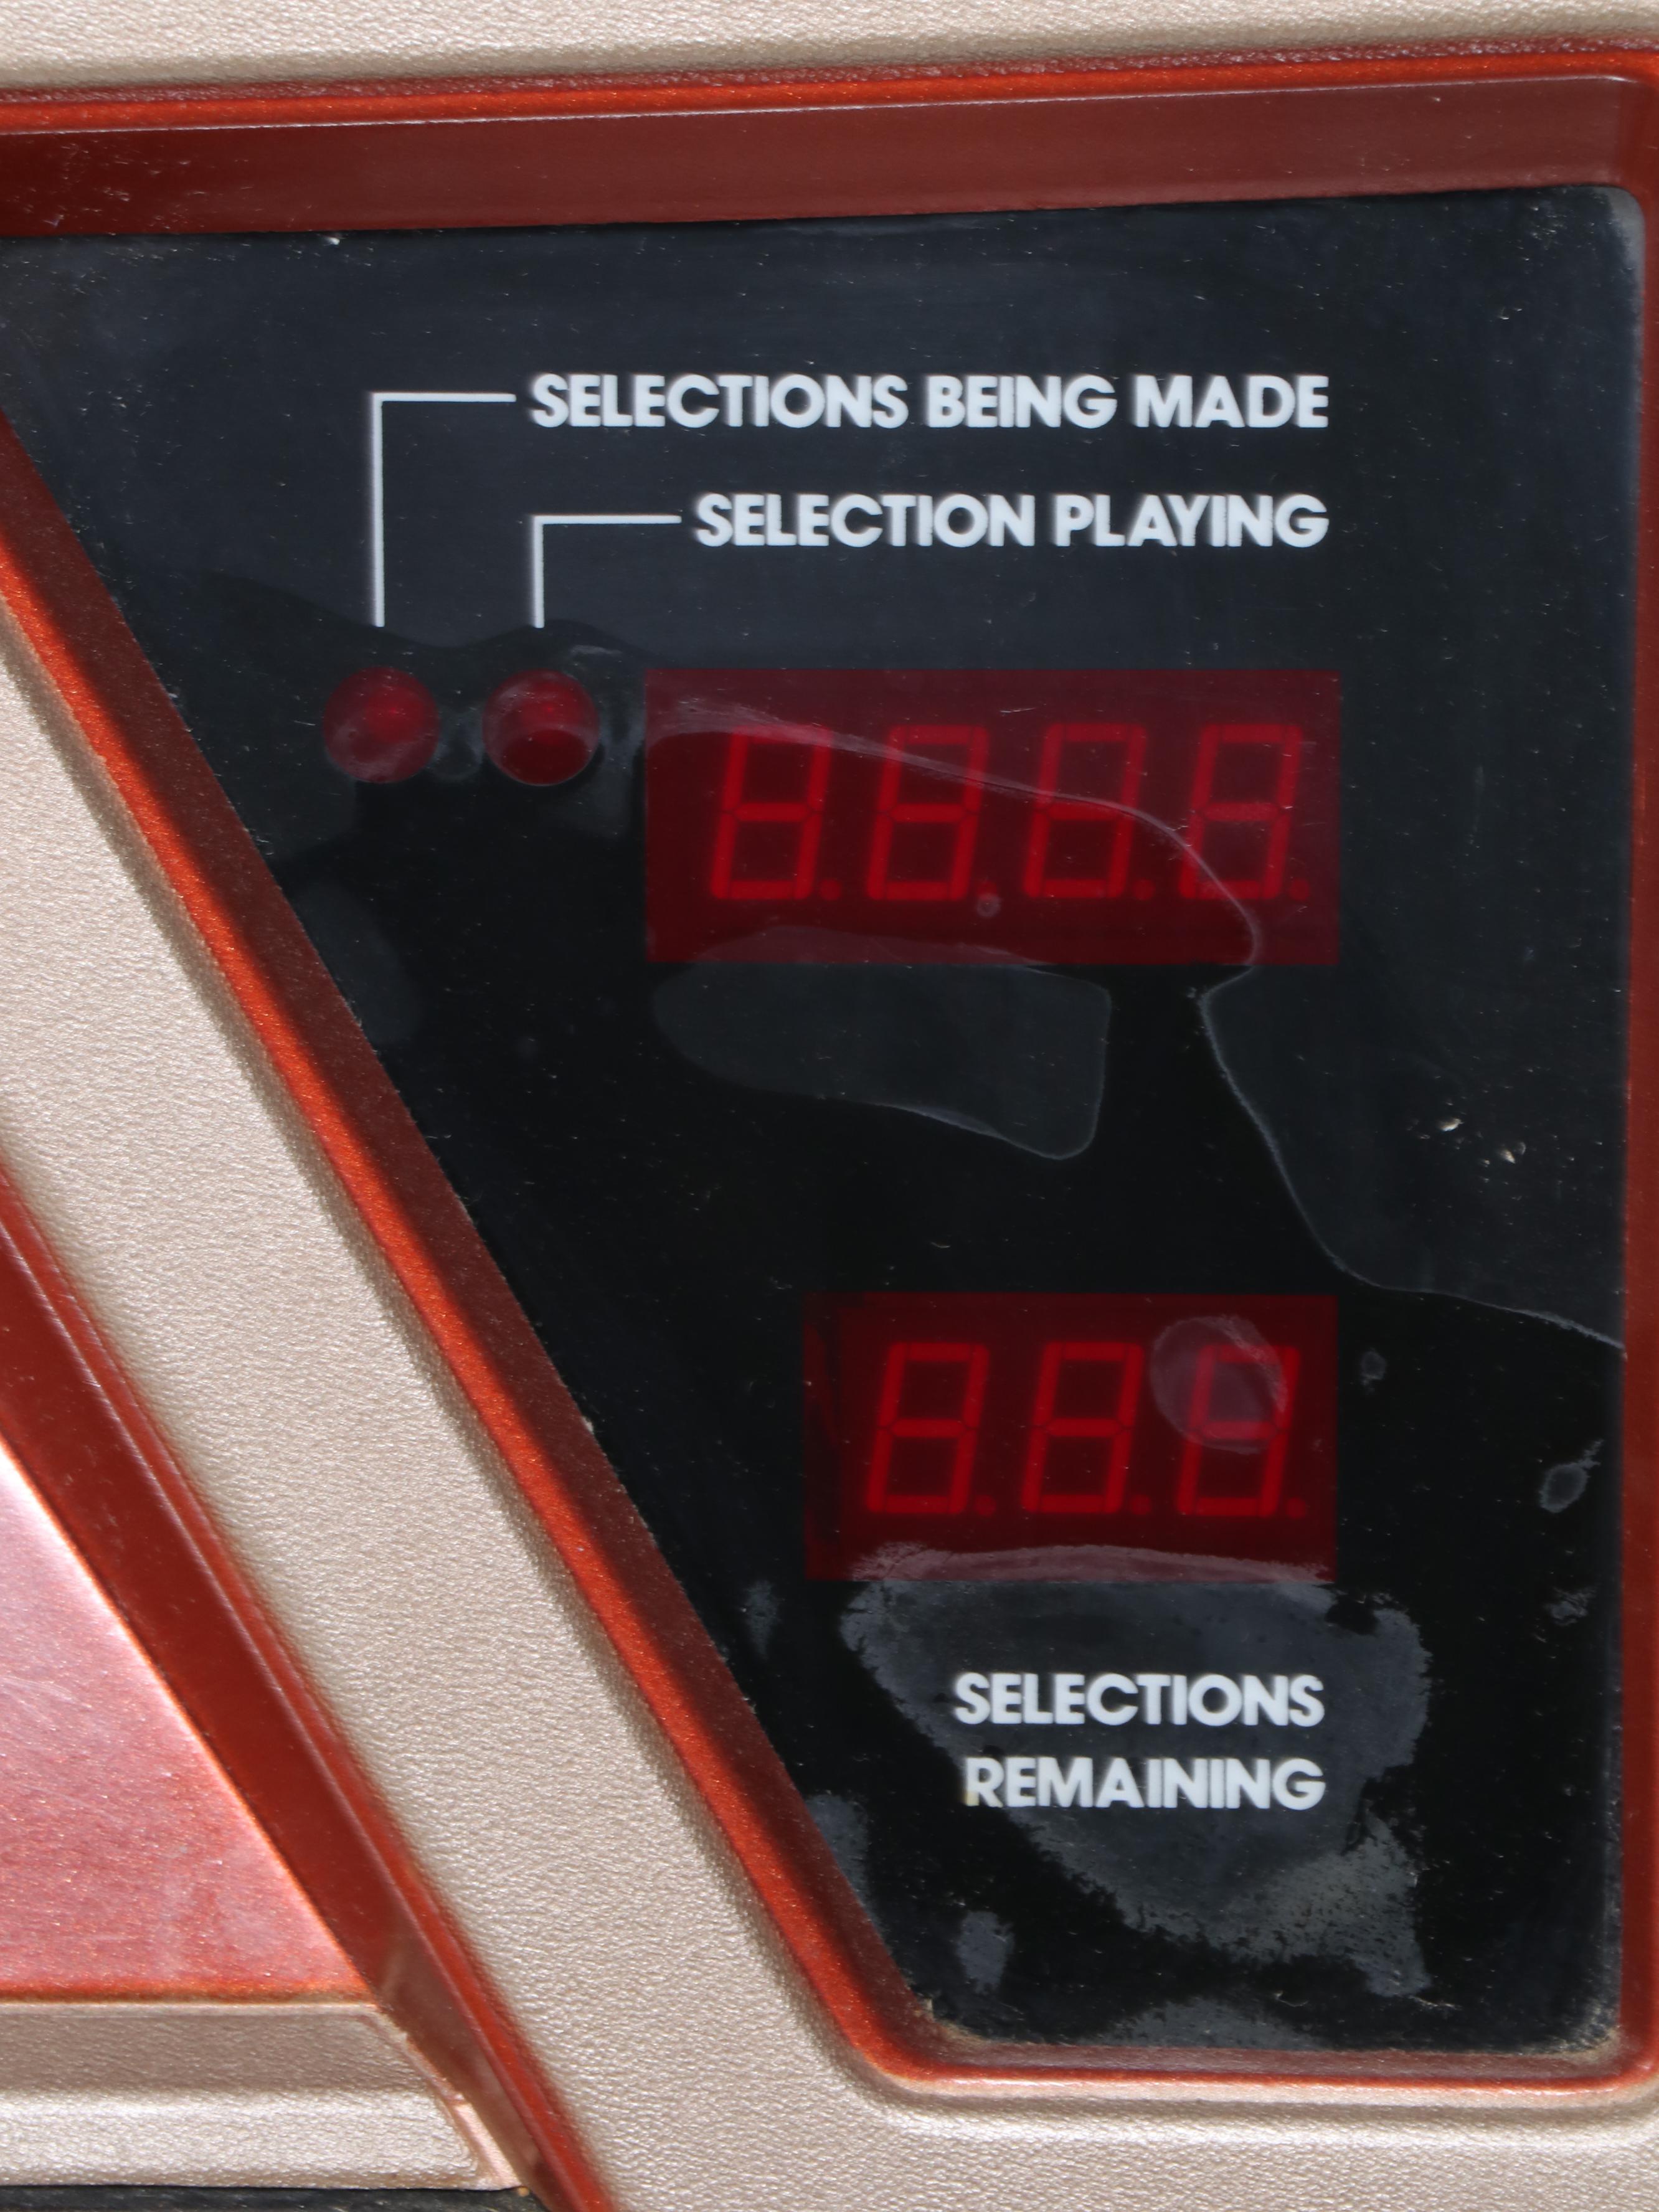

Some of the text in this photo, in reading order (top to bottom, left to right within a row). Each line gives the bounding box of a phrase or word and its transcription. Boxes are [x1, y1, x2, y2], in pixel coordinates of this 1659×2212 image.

[529, 372, 1330, 429] SELECTIONS BEING MADE
[694, 492, 1330, 549] SELECTION PLAYING
[953, 1671, 1325, 1728] SELECTIONS
[963, 1755, 1326, 1811] REMAINING
